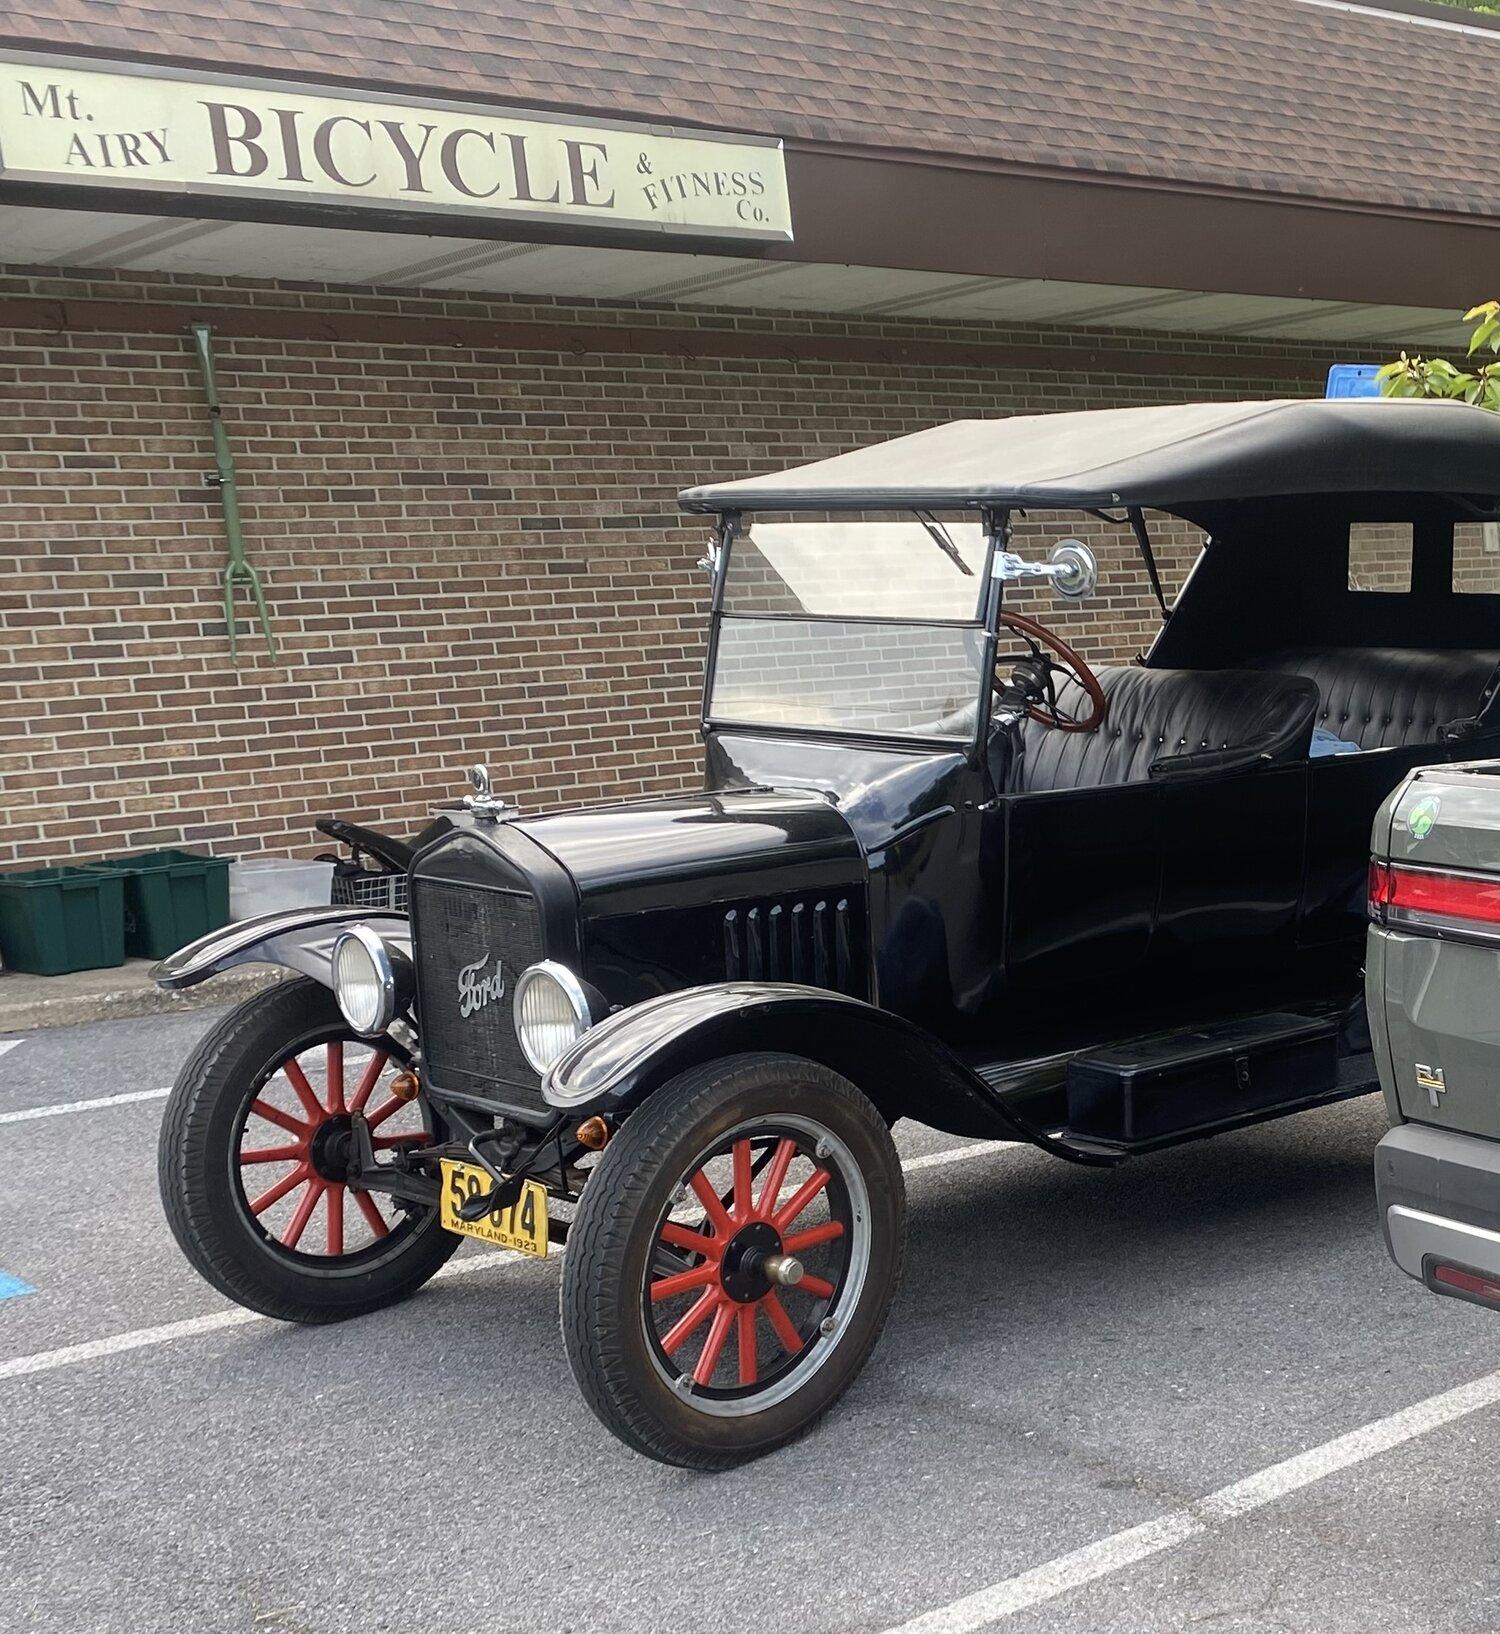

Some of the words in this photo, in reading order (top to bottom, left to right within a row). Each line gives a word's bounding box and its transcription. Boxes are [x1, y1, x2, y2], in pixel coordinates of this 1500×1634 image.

[16, 80, 94, 121] Mt.
[64, 127, 174, 168] AIRY
[200, 100, 616, 209] BICYCLE
[636, 152, 653, 175] &
[642, 171, 766, 210] FITNESS
[736, 199, 770, 222] Co.
[458, 953, 505, 1018] Ford
